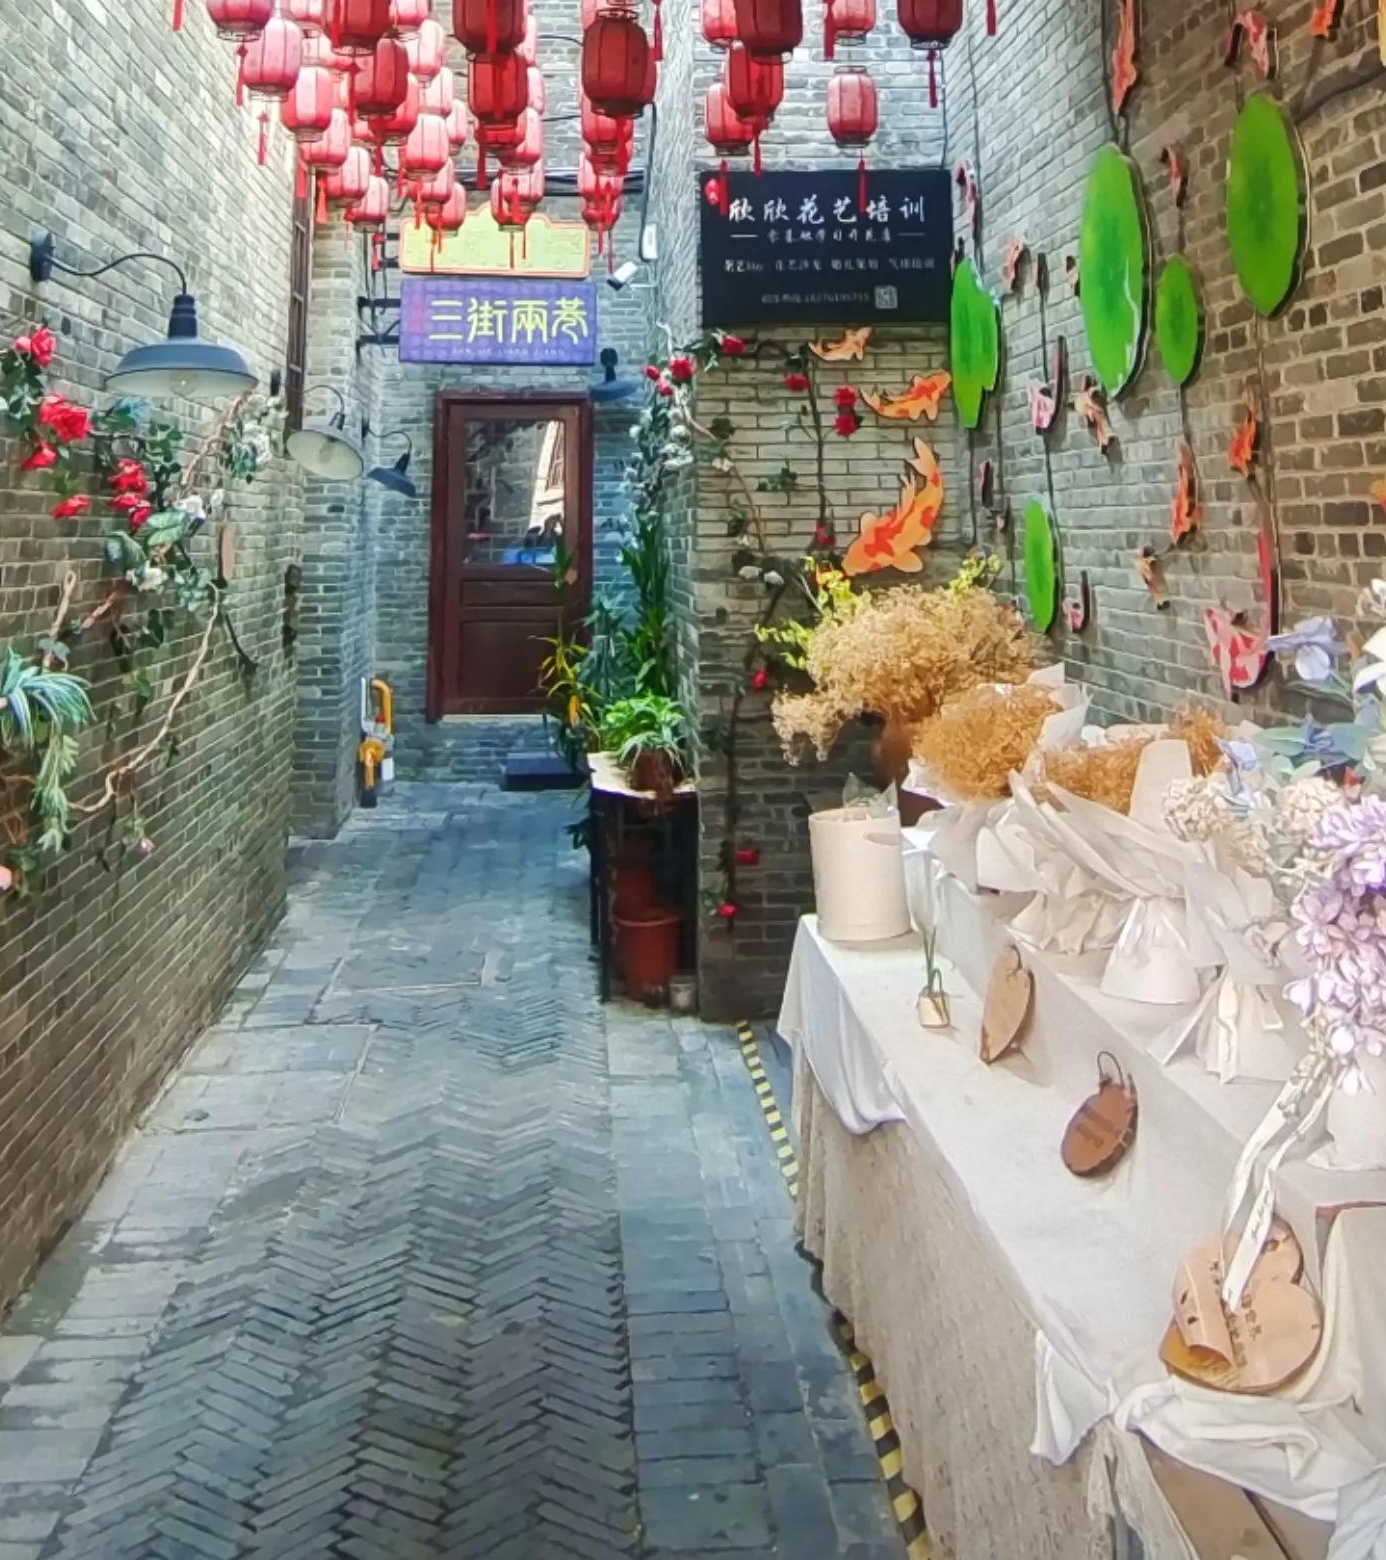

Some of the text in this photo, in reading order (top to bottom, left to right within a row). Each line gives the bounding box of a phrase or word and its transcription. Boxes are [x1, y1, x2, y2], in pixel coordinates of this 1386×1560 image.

[729, 195, 926, 225] 欣欣花艺培训
